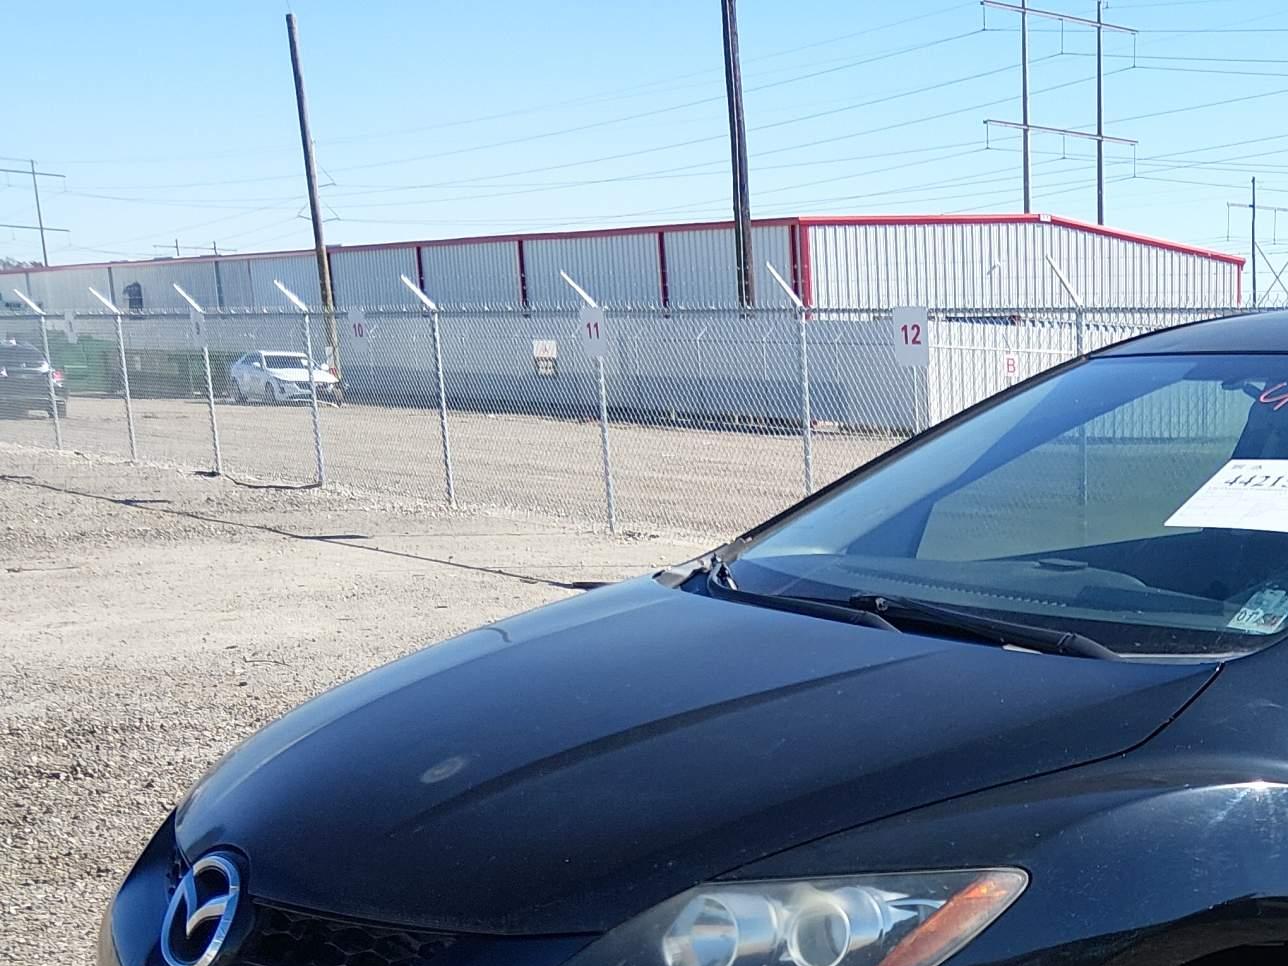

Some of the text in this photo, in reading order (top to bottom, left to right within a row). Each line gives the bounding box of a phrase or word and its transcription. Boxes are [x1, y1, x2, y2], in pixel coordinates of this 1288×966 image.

[352, 322, 364, 338] 10
[586, 322, 599, 340] 11
[900, 324, 922, 345] 12
[1006, 358, 1016, 373] B
